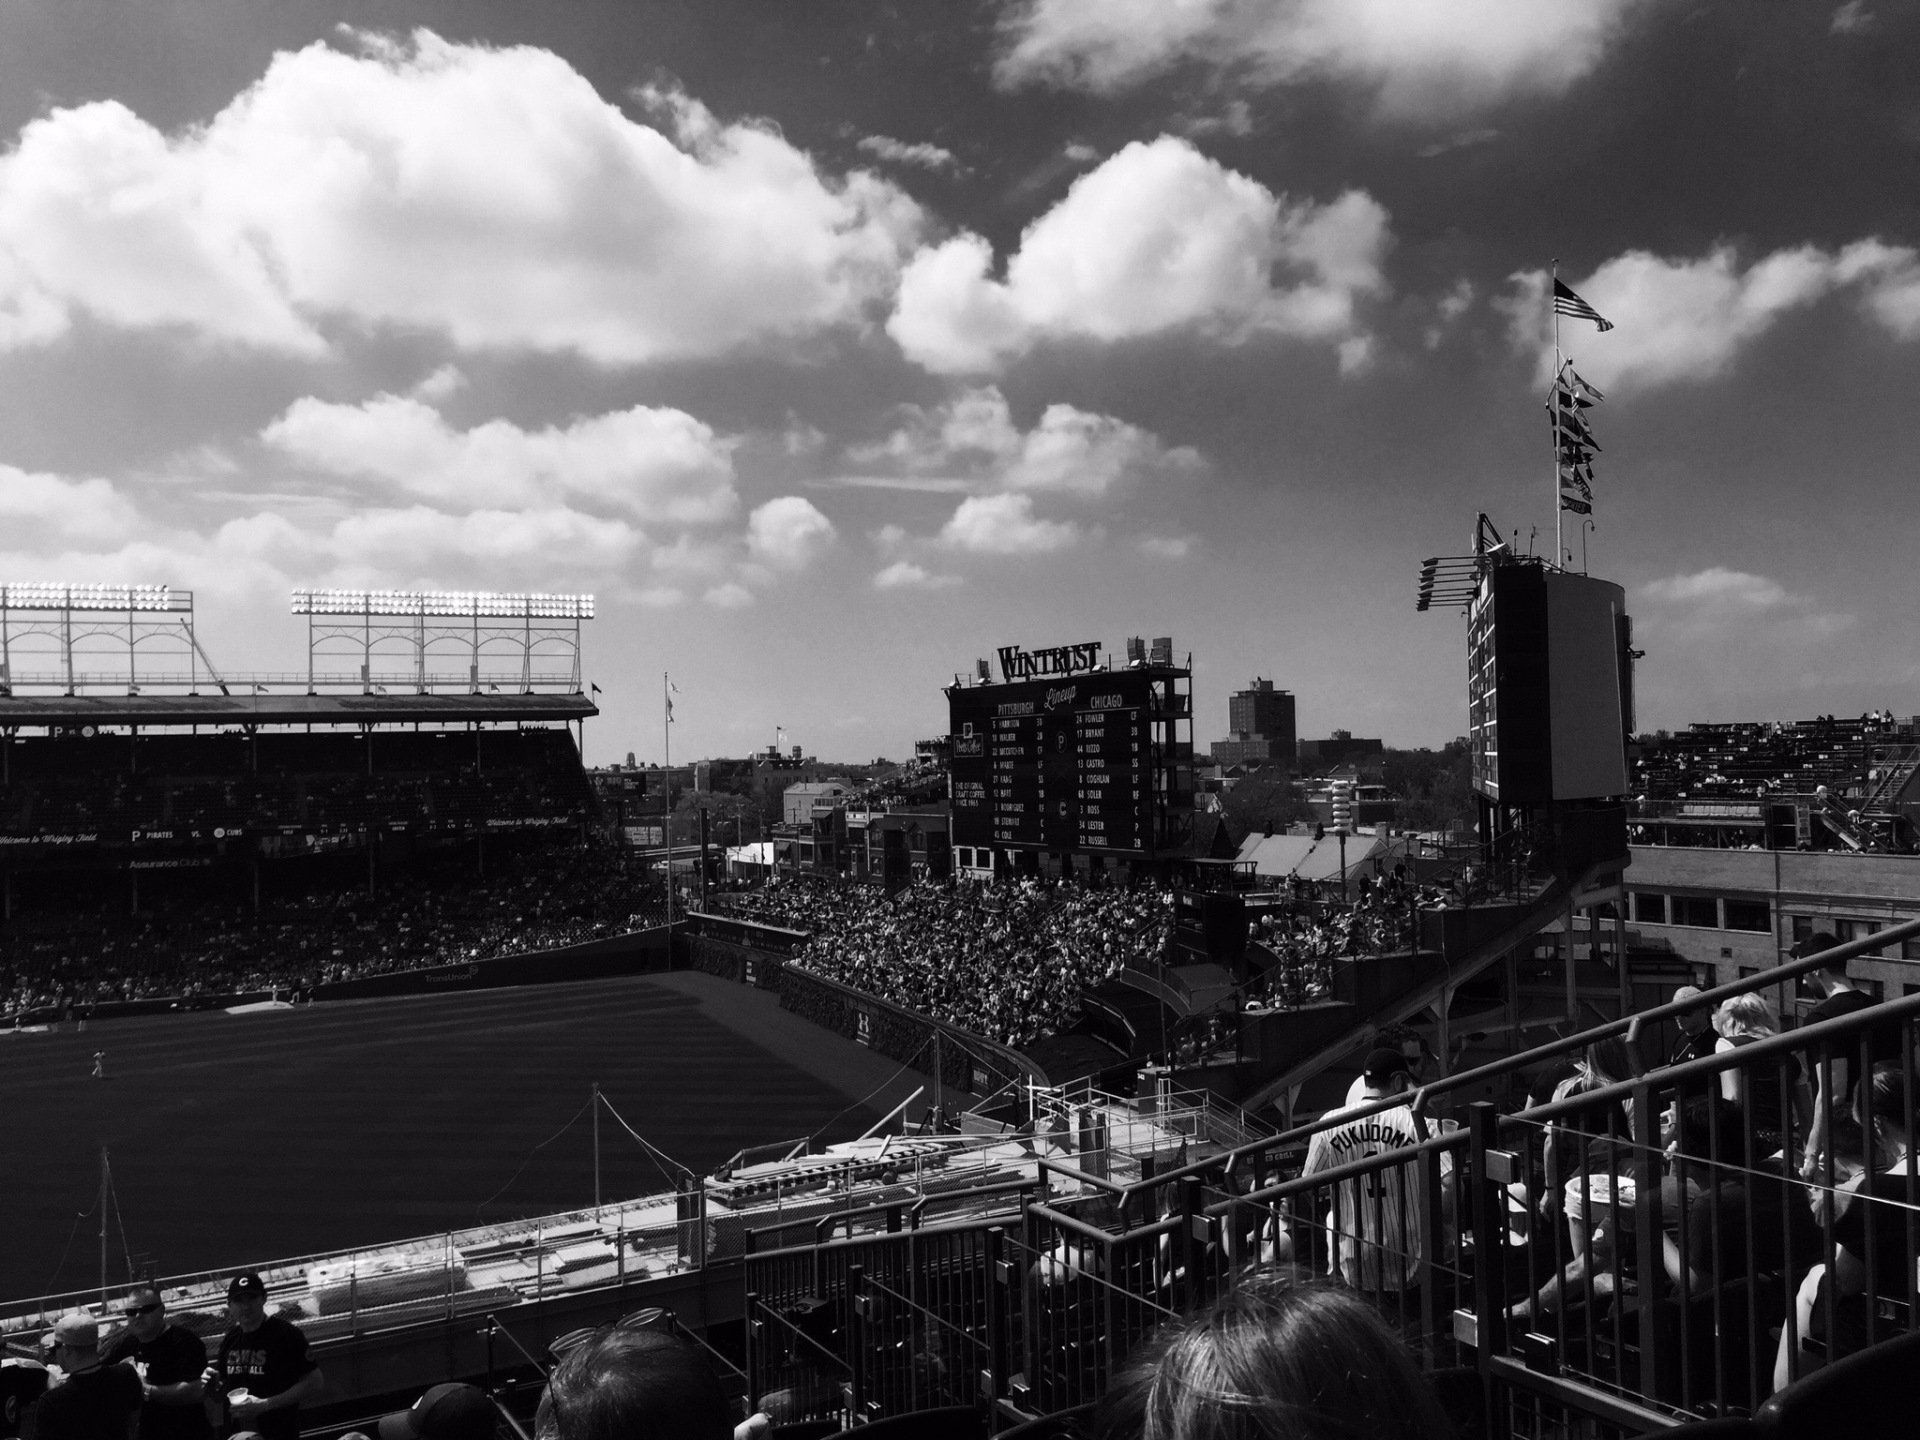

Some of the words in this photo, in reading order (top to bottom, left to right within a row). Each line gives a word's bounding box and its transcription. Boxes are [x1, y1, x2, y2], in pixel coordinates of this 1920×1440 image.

[997, 642, 1101, 678] WINTRUST
[1044, 685, 1076, 711] Lineup
[1090, 694, 1122, 709] CHICAGO
[998, 702, 1034, 715] PITTSBURGH
[1076, 715, 1082, 724] 24
[1085, 713, 1105, 723] FOWLER
[1130, 711, 1137, 721] CF
[1077, 729, 1083, 739] 17
[1085, 729, 1105, 738] BRYANT
[1077, 744, 1083, 754] 44
[1086, 744, 1101, 753] RIZZO
[1078, 759, 1084, 768] 13
[1086, 759, 1105, 768] CASTRO
[1132, 758, 1139, 768] SS
[1087, 774, 1110, 784] COGHLAN
[1132, 774, 1139, 784] LF
[956, 790, 969, 798] CRAFT
[969, 790, 985, 798] COFFEE
[1087, 790, 1102, 799] SOLER
[1080, 805, 1084, 814] 3
[1087, 805, 1100, 815] ROSS
[1135, 806, 1139, 816] C
[486, 818, 515, 826] Welcome
[524, 817, 550, 827] Wrigley
[551, 816, 569, 825] Field
[1079, 821, 1085, 829] 34
[1088, 821, 1104, 830] LESTER
[1135, 823, 1139, 832] P
[31, 835, 40, 844] to
[42, 835, 74, 845] Wrigley
[75, 833, 98, 842] Field
[132, 830, 141, 842] P
[146, 831, 174, 839] PIRATES
[226, 828, 243, 836] CUBS
[1080, 835, 1086, 845] 22
[1088, 836, 1108, 846] RUSSELL
[1134, 838, 1141, 848] 2B
[130, 860, 178, 869] Assurance
[180, 859, 200, 867] Club
[425, 973, 471, 983] TransUnion
[238, 1277, 249, 1287] C
